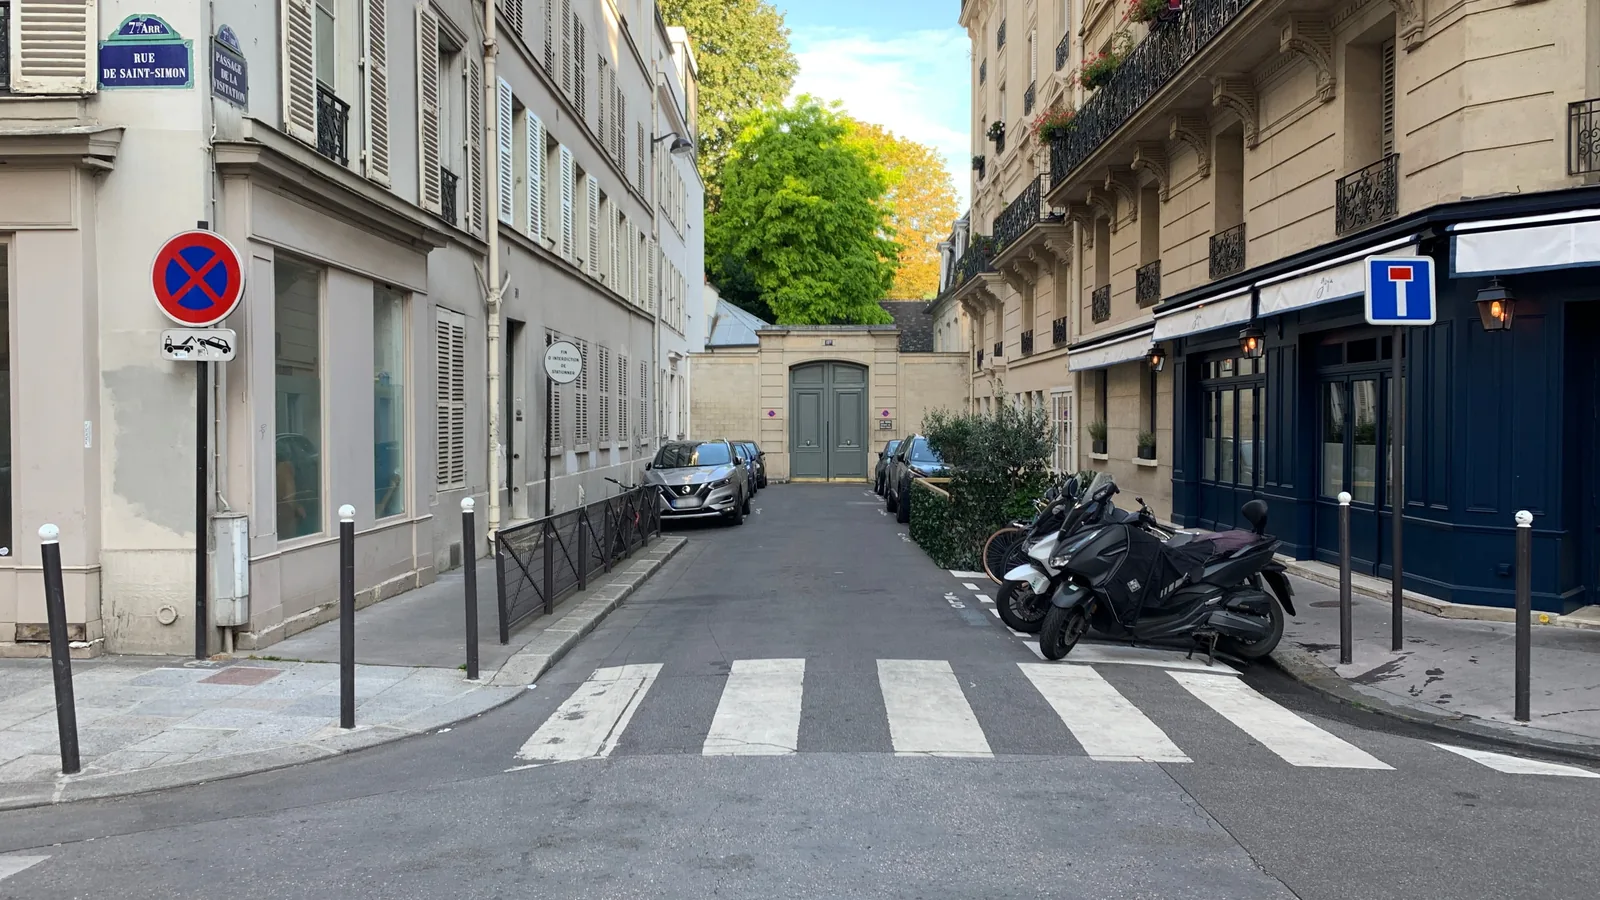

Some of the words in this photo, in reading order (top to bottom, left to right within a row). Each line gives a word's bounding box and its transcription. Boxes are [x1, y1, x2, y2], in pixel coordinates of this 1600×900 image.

[133, 52, 155, 63] RUE
[215, 51, 242, 76] PASSAGE
[103, 68, 117, 79] DE
[119, 67, 186, 79] SAINT-SIMON
[220, 68, 230, 82] DE
[229, 72, 238, 87] LA
[212, 79, 246, 103] VISITATION
